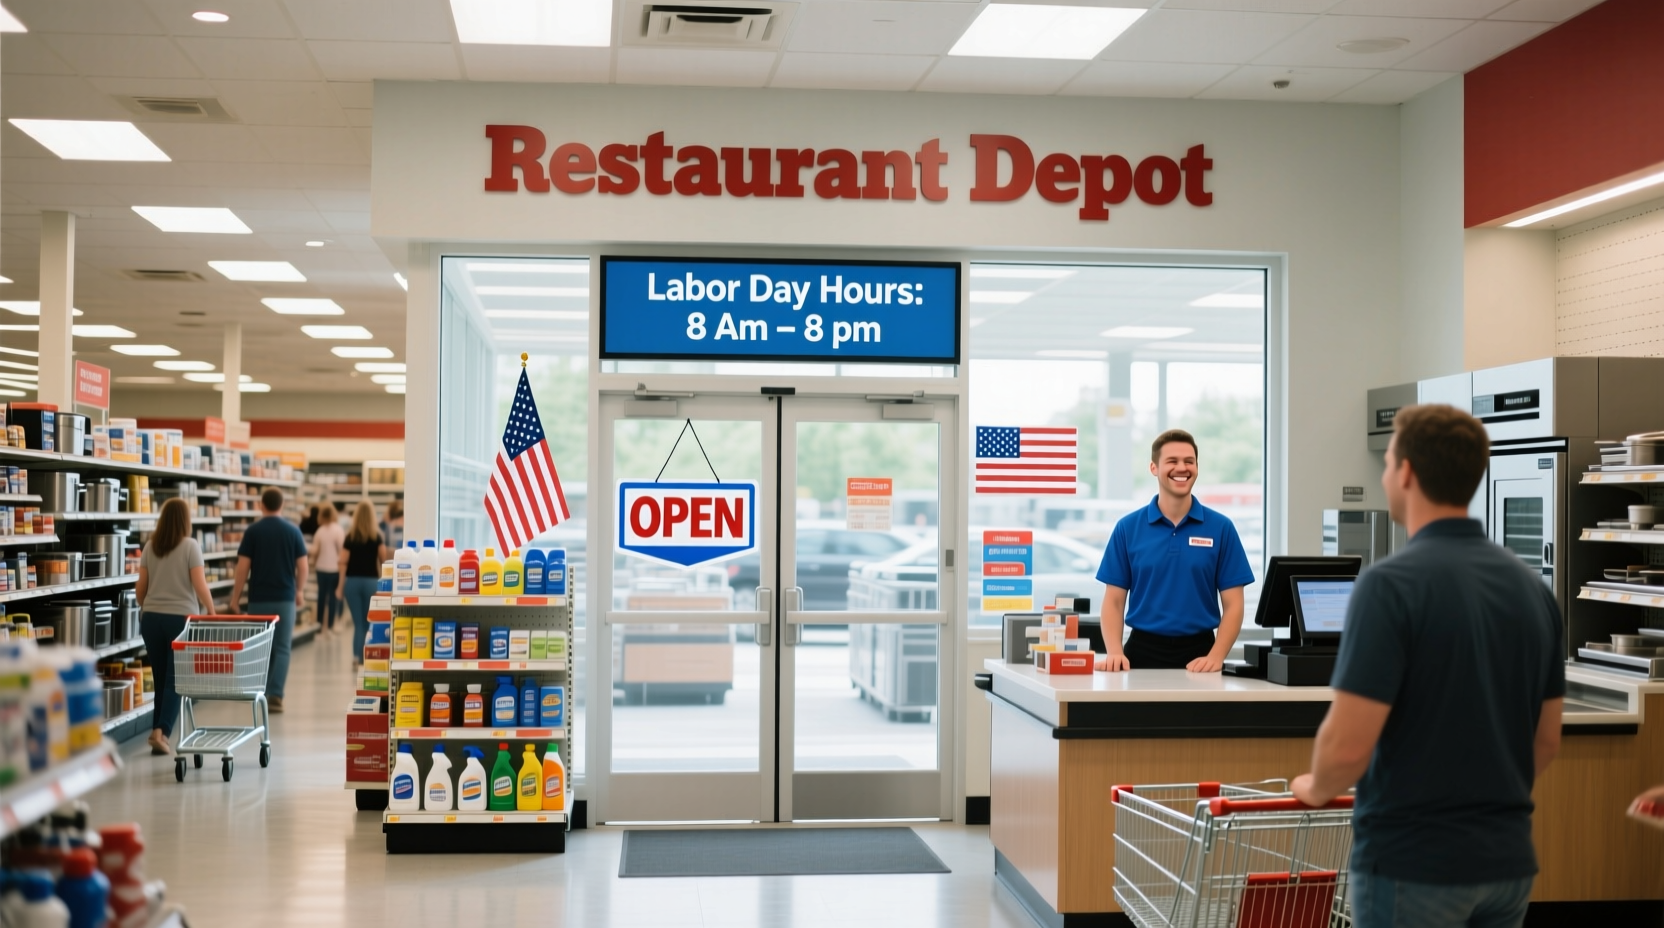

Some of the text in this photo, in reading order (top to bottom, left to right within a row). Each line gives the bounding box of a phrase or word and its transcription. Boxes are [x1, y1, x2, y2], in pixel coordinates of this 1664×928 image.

[485, 125, 1213, 220] Restaurant Depot
[648, 272, 923, 309] Labor Day Hours:
[686, 311, 707, 340] 8
[713, 312, 768, 341] Am
[803, 313, 824, 342] 8
[832, 321, 881, 349] pm
[630, 496, 744, 538] OPEN
